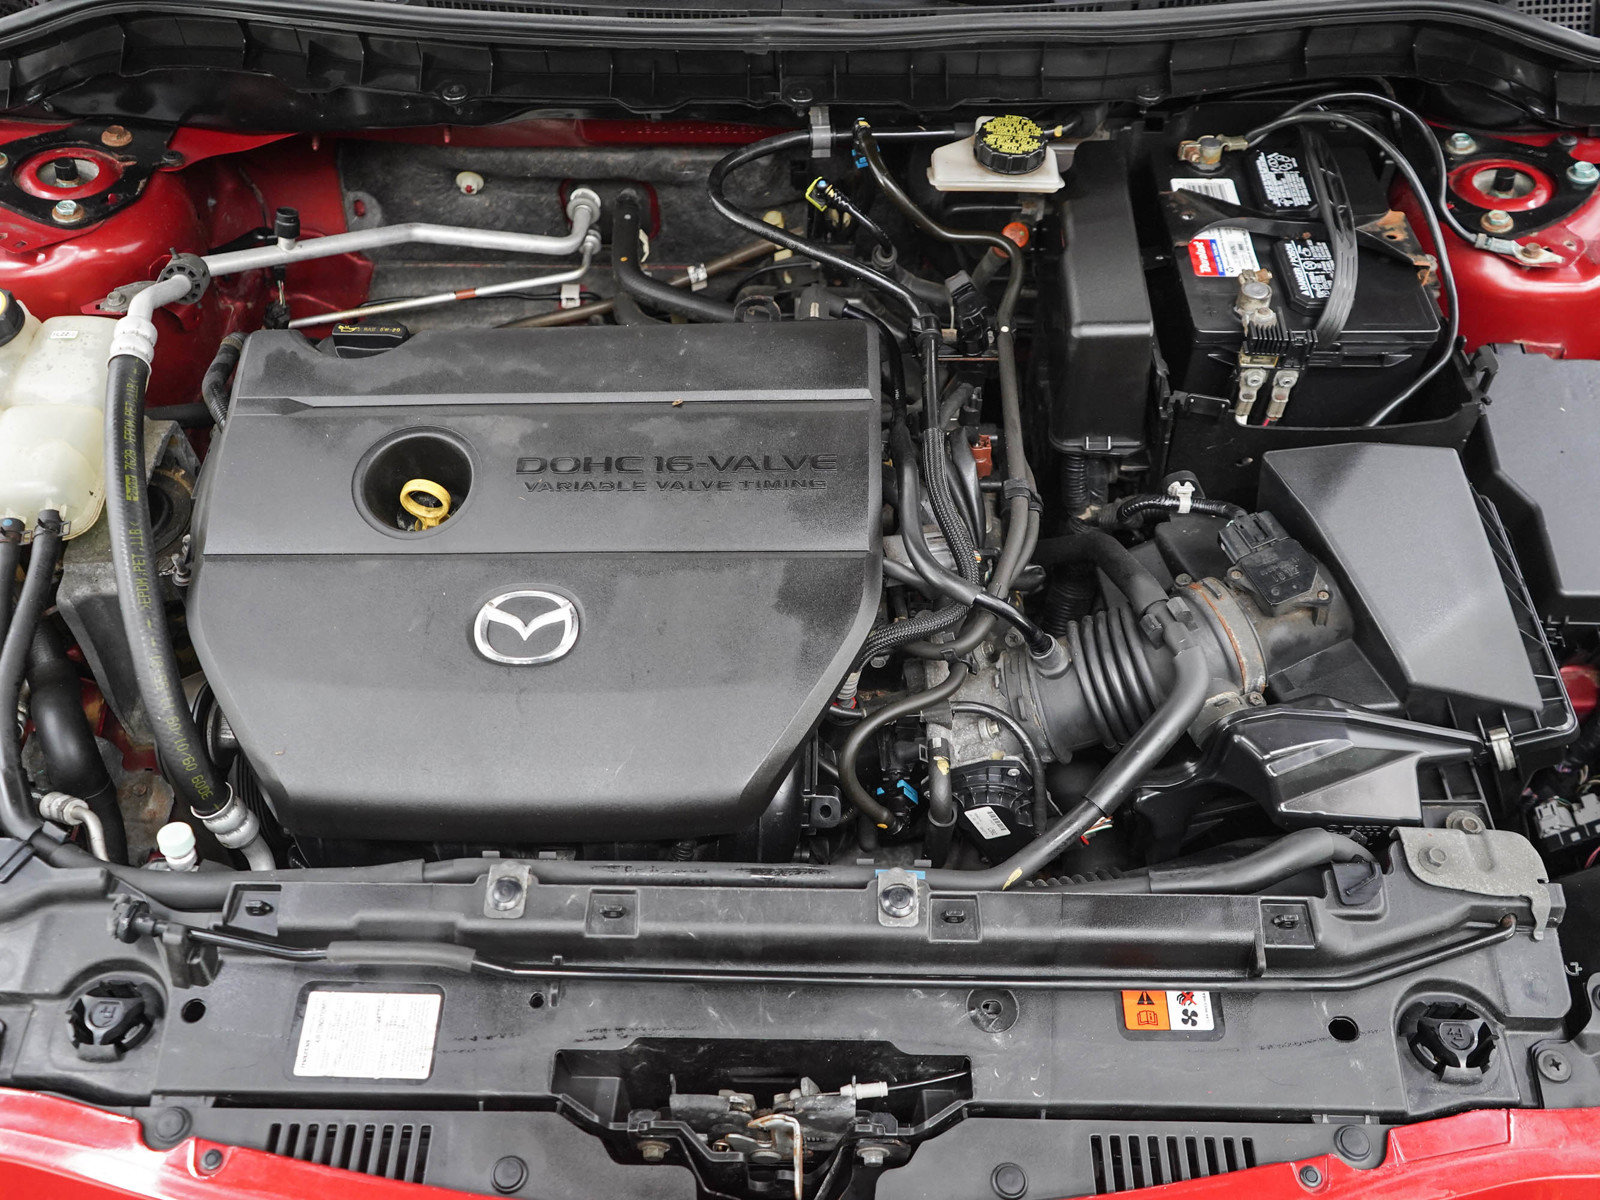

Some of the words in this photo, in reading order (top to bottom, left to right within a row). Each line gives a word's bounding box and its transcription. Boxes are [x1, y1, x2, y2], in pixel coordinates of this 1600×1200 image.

[516, 456, 644, 475] DOHC
[653, 454, 838, 474] 16-VALVE
[524, 480, 648, 492] VARIABLE
[655, 479, 733, 492] VALVE
[738, 478, 828, 490] TIMING
